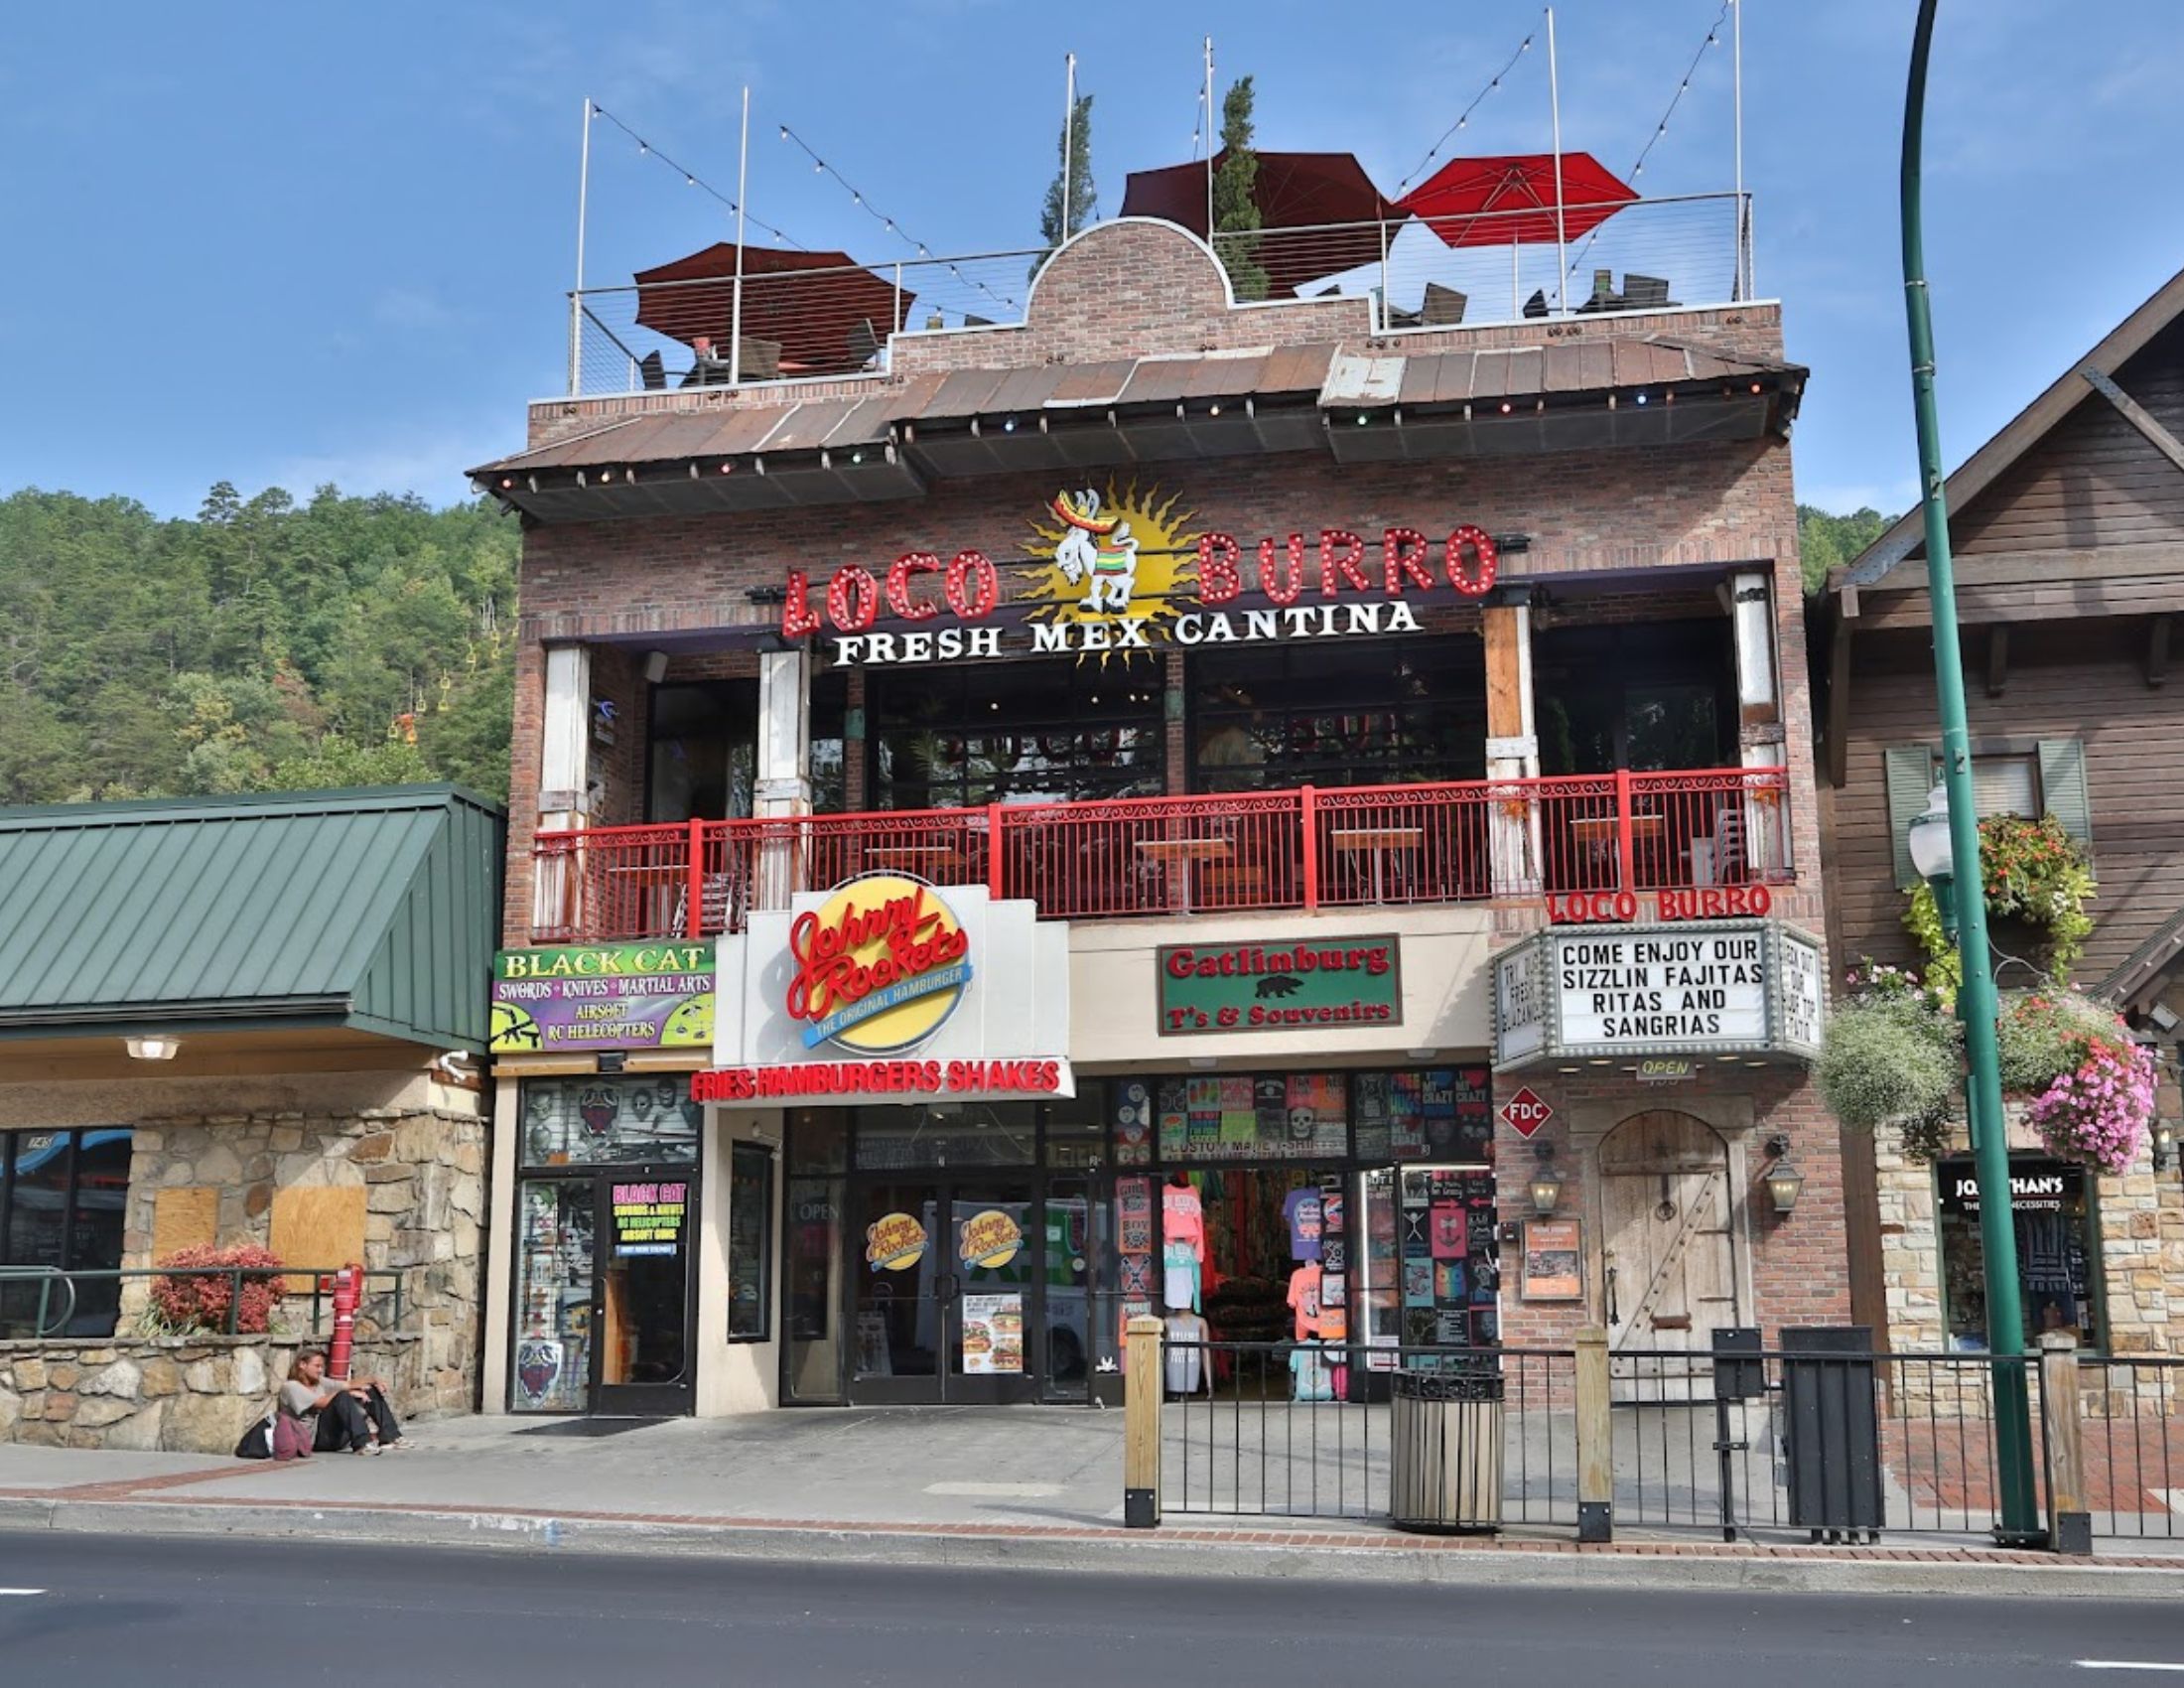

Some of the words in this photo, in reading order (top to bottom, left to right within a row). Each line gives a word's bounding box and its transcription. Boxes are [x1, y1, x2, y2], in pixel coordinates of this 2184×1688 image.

[782, 548, 999, 637] LOCO
[1198, 523, 1498, 606] BURRO
[832, 628, 1003, 667] FRESH
[1029, 616, 1150, 656] MEX
[1174, 600, 1426, 645] CANTINA
[1546, 891, 1637, 923] LOCO
[1658, 884, 1772, 919] BURRO
[786, 885, 941, 1011] Johnny
[1166, 944, 1390, 979] Gatlinburg
[1563, 944, 1623, 965] COME
[1634, 941, 1704, 963] ENJOY
[1713, 939, 1757, 960] OUR
[504, 951, 622, 979] BLACK
[633, 946, 705, 974] CAT
[804, 920, 969, 1018] Rockets
[1563, 969, 1649, 989] SIZZLIN
[1665, 963, 1764, 986] FAJITAS
[498, 980, 553, 1001] SWORDS
[562, 978, 610, 999] KNIVES
[618, 976, 675, 997] MARTIAL
[678, 974, 711, 993] ARTS
[1593, 992, 1662, 1013] RITAS
[1682, 989, 1725, 1011] AND
[576, 1002, 627, 1021] AIRSOFT
[816, 1018, 836, 1041] THE
[838, 994, 890, 1029] ORIGINAL
[892, 967, 964, 1004] HAMBURGER
[1167, 1006, 1209, 1029] T's
[1217, 1006, 1240, 1026] &
[1248, 1000, 1392, 1025] Souvenirs
[1603, 1014, 1721, 1038] SANGRIAS
[1642, 1059, 1690, 1074] OPEN
[691, 1068, 755, 1104] FRIES
[756, 1060, 941, 1098] HAMBURGERS
[945, 1059, 1060, 1094] SHAKES
[1422, 1089, 1453, 1104] CRAZY
[1508, 1101, 1543, 1121] FDC
[613, 1183, 659, 1204] BLACK
[659, 1182, 687, 1203] CAT
[799, 1203, 840, 1220] OPEN
